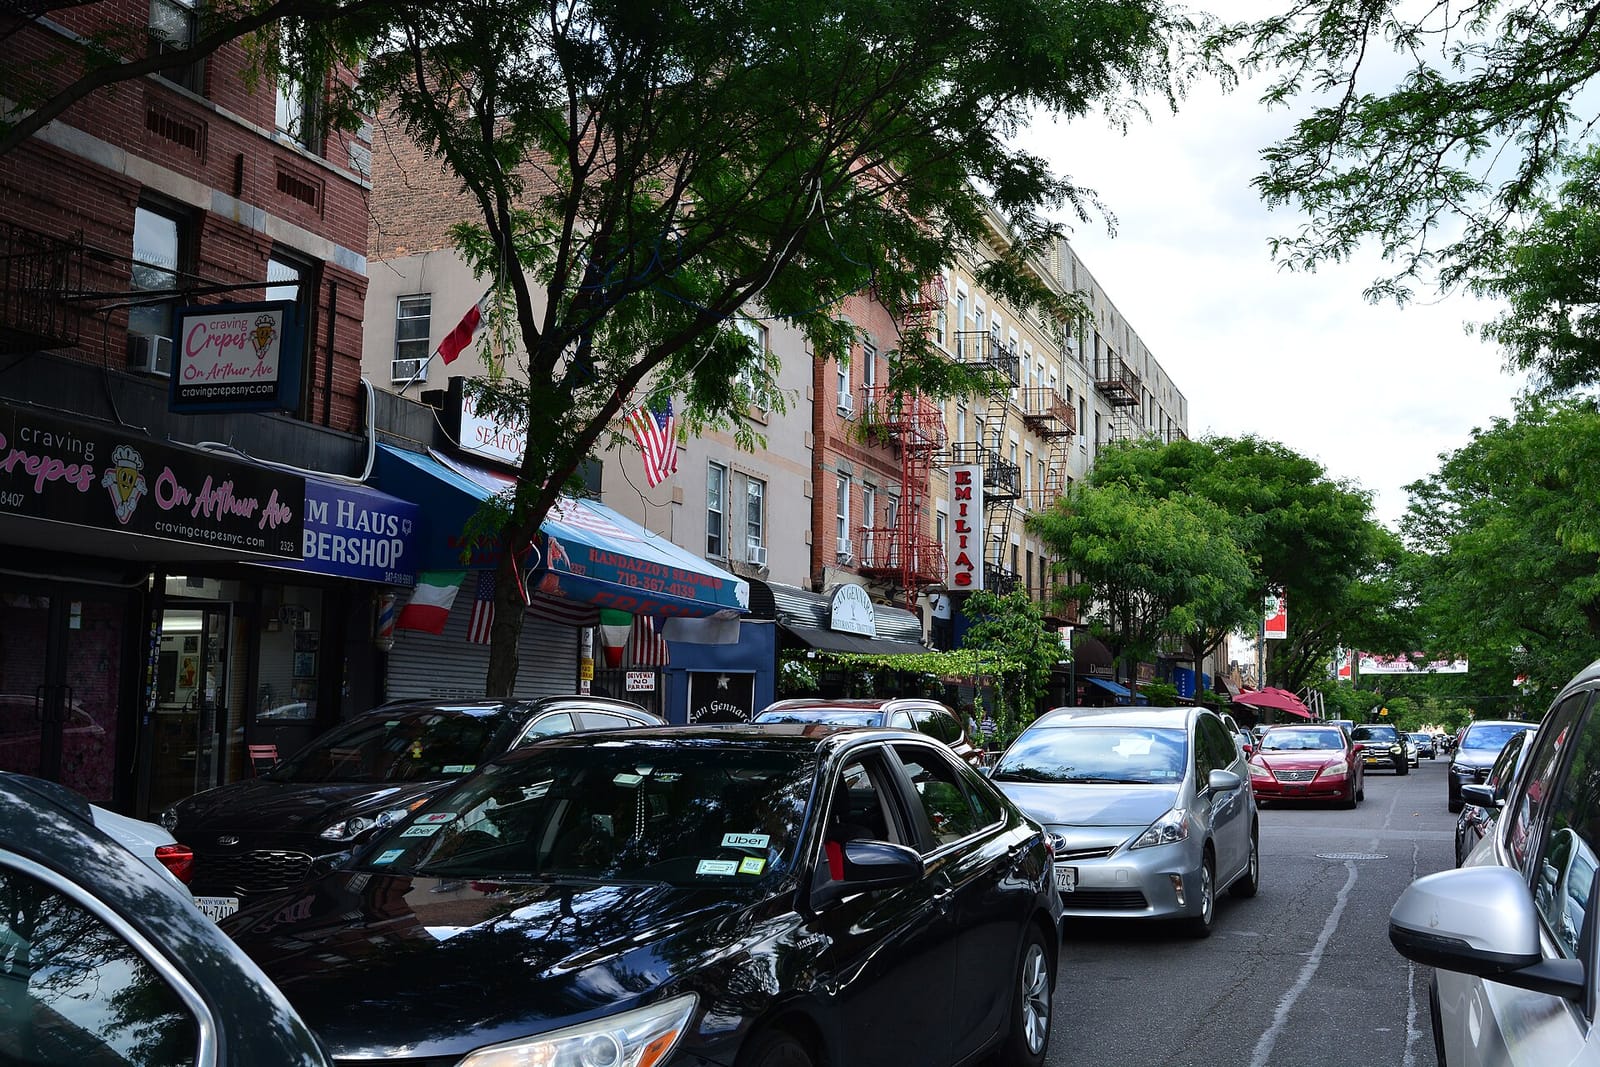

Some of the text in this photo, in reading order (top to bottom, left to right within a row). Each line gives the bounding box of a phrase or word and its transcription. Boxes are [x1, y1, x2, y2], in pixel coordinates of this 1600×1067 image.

[210, 317, 248, 332] craving
[186, 322, 246, 358] Crepes
[184, 360, 273, 381] On Arthur Ave
[182, 383, 274, 398] cravingcrepesnyc.com
[20, 427, 95, 461] craving
[0, 432, 96, 494] repes
[154, 467, 292, 530] On Arthur Ave
[303, 498, 328, 525] M
[155, 521, 265, 548] cravingcrepesnyc.com
[280, 540, 294, 552] 2325
[617, 570, 696, 598] 718-367-4139
[407, 827, 434, 835] Uber
[727, 835, 764, 845] Uber
